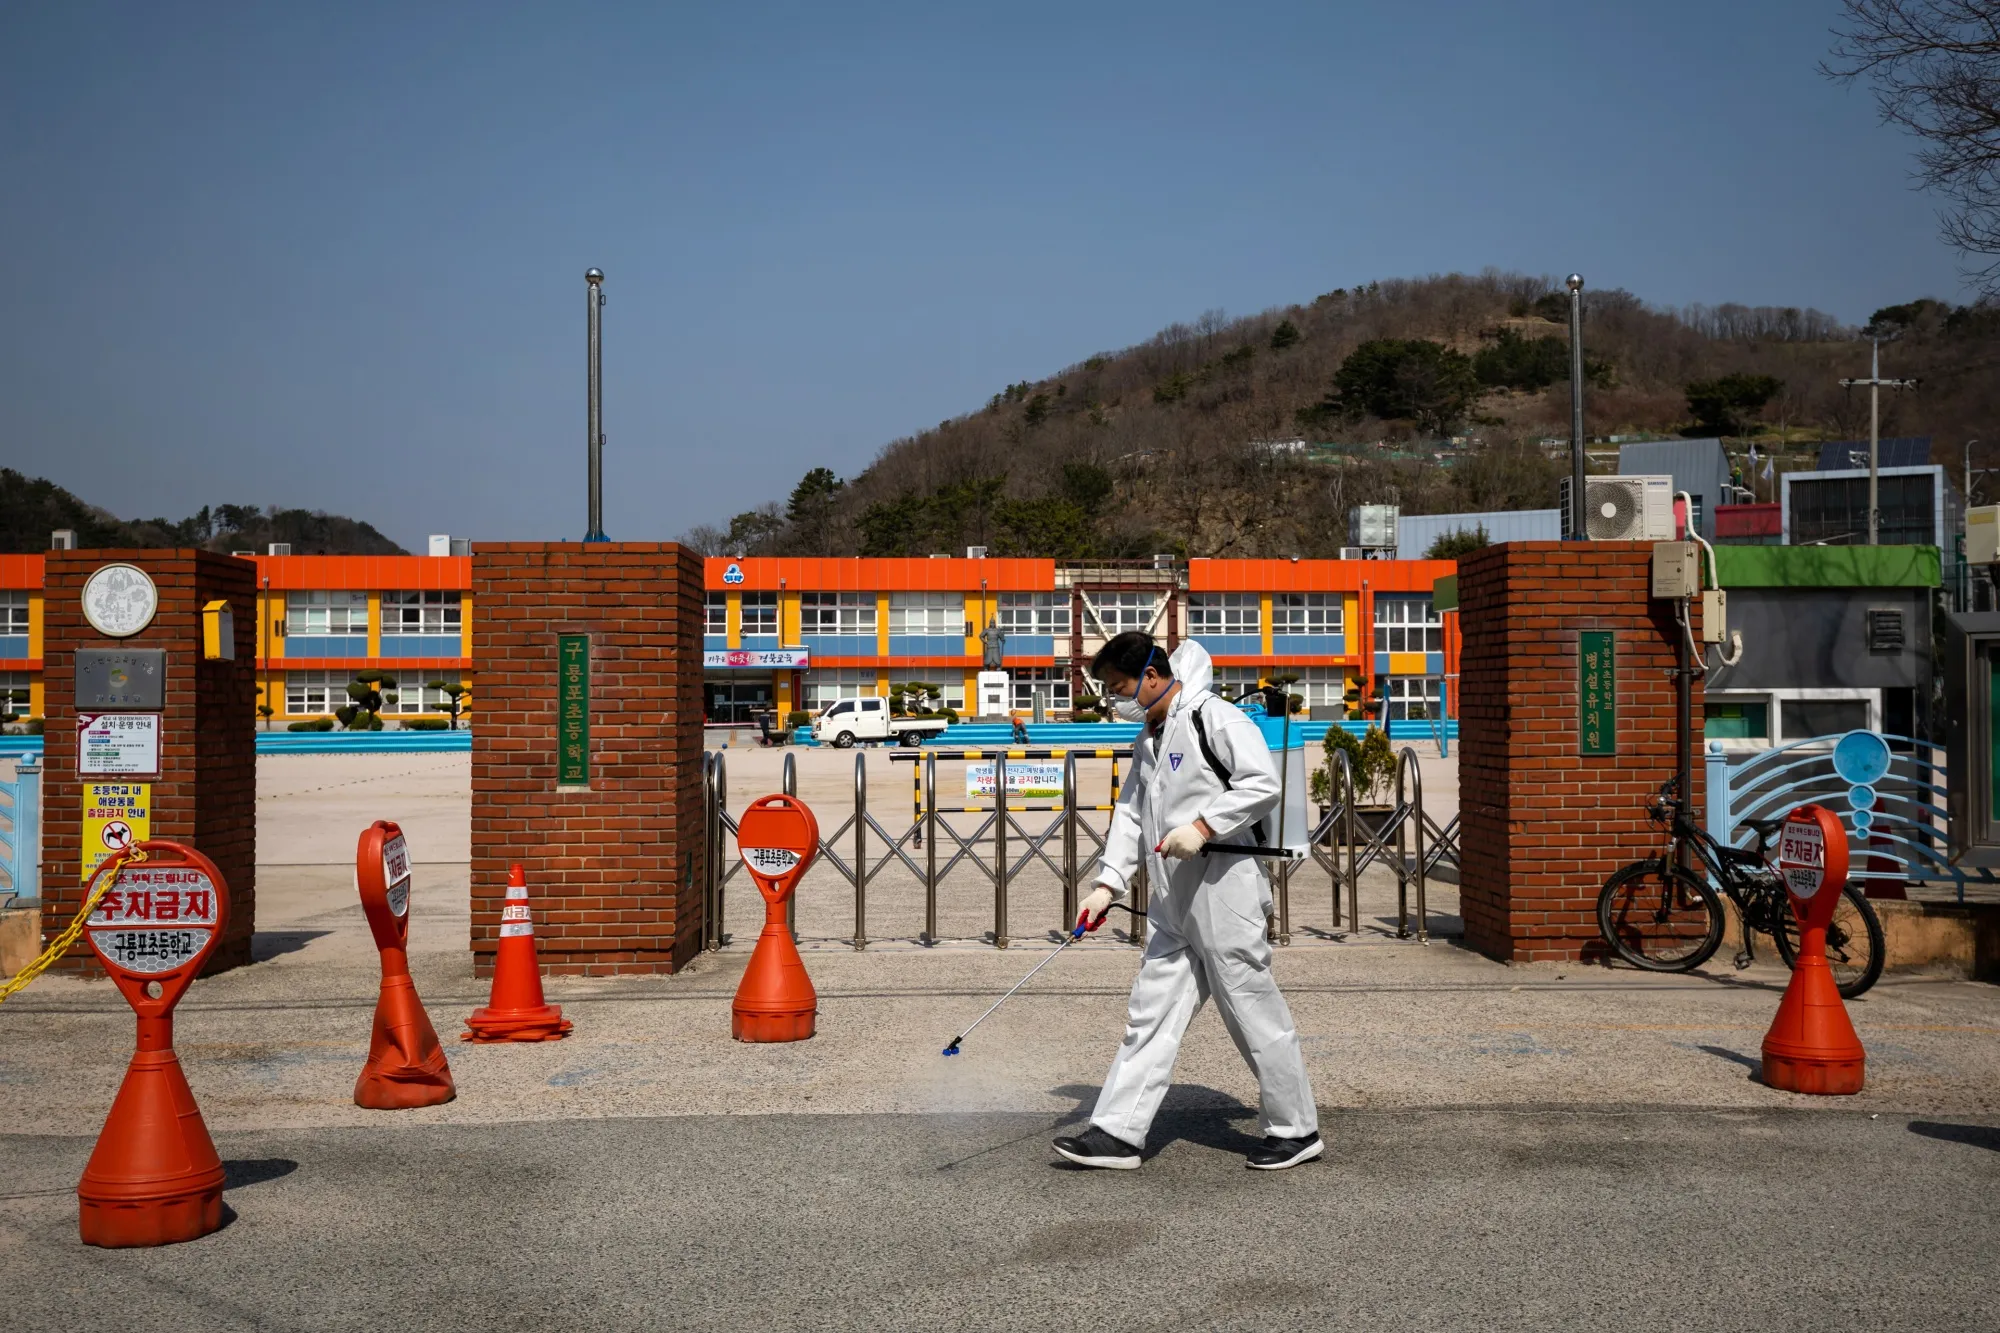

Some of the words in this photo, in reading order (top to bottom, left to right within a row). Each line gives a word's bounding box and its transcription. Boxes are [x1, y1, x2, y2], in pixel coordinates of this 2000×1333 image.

[729, 653, 755, 664] 따뜻한
[759, 653, 793, 664] 경북교육
[1601, 636, 1613, 710] 구룡포초등학교
[1585, 651, 1600, 748] 병설유치원
[565, 641, 584, 779] 구룡포초등학교
[135, 721, 152, 729] 안내
[976, 776, 1016, 784] 차량을
[1018, 776, 1057, 784] 금지합니다
[93, 785, 129, 795] 초등학교
[133, 785, 141, 795] 내
[98, 797, 135, 806] 애완동물
[87, 808, 124, 818] 출입금지
[128, 808, 146, 818] 안내
[754, 849, 793, 867] 구룡포초등학교
[131, 873, 151, 884] 부탁
[153, 873, 199, 884] 드립니다
[97, 890, 210, 920] 주차금지
[114, 932, 192, 961] 구룡포초등학교
